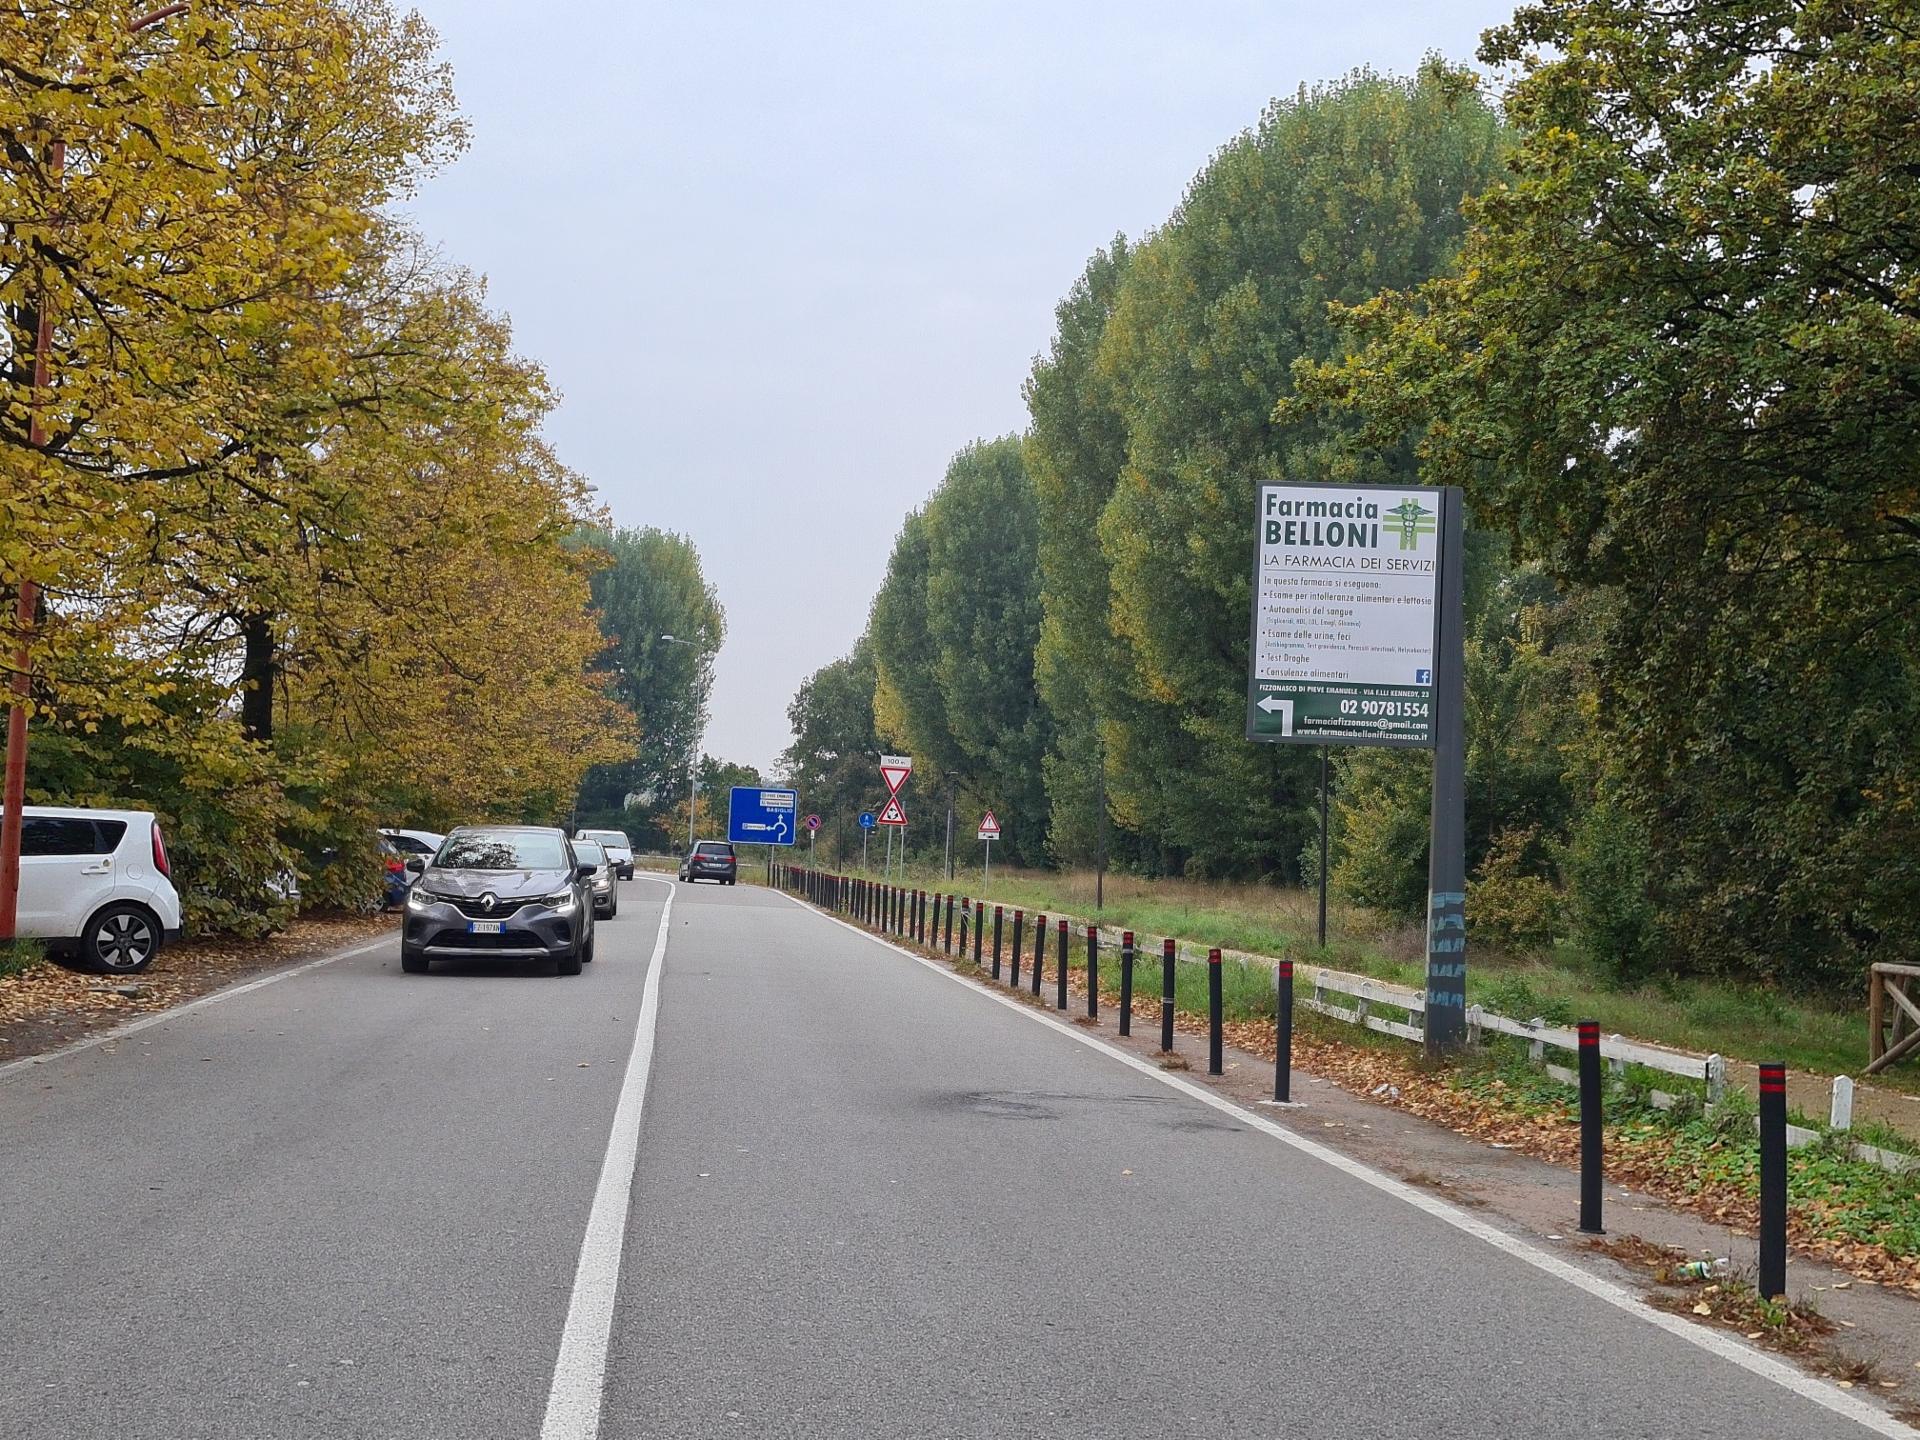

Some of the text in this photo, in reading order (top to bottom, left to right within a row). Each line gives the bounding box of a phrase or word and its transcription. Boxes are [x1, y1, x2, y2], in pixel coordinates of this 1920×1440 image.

[1266, 494, 1378, 519] Farmacia
[1265, 520, 1378, 548] BELLONI
[1264, 554, 1434, 571] LA FARMACIA DEI SERVIZI
[1264, 576, 1382, 590] In questa farmacia si eseguono:
[1269, 591, 1293, 599] Esame
[1295, 593, 1307, 602] per
[1310, 592, 1354, 602] intolleranze
[1356, 594, 1395, 604] alimentari
[1404, 595, 1432, 605] lattosio
[1268, 605, 1311, 615] Autoanalisi
[1327, 609, 1353, 618] sangue
[1267, 629, 1351, 641] Esame delle urine, feci
[1267, 653, 1310, 664] Test Droghe
[1266, 667, 1349, 679] Consulenze alimentari
[1259, 684, 1297, 692] FIZZONASCO
[1298, 685, 1306, 693] DI
[1326, 687, 1358, 695] EMANUELE
[1390, 689, 1420, 698] KENNEDY,
[1340, 699, 1429, 718] 02 90781554
[1304, 715, 1428, 730] farmaciafizzonasco@gmail.com
[1296, 727, 1428, 741] www.farmaciabellonifizzonasco.it
